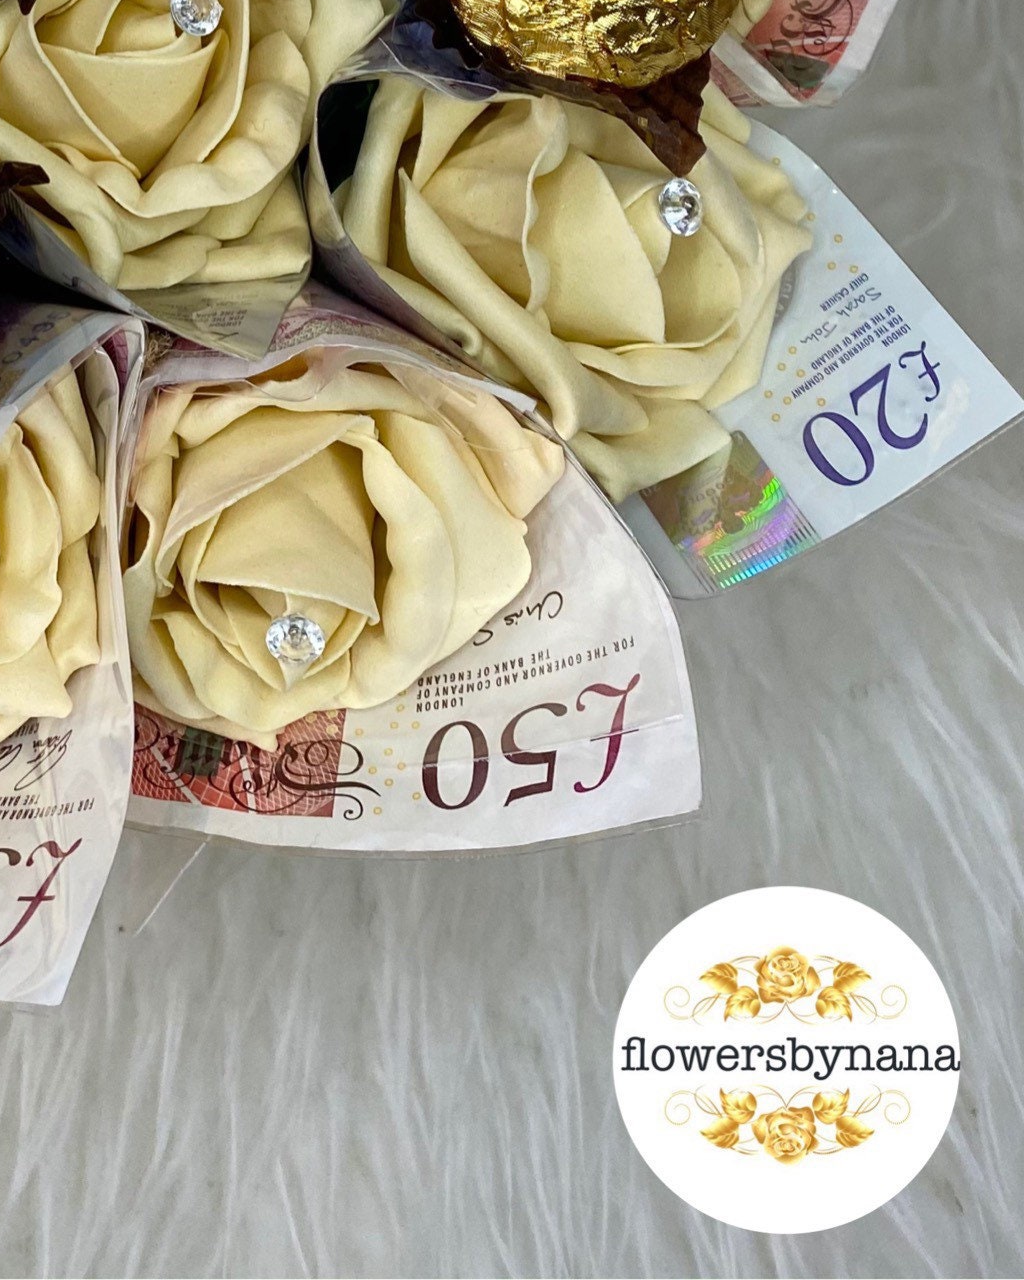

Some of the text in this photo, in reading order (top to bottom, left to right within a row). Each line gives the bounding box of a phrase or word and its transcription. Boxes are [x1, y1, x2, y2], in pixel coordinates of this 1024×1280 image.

[849, 272, 869, 292] CHIEF
[819, 287, 850, 312] CASHIER
[810, 305, 896, 371] OF THE BANK OF ENGLAND
[881, 323, 912, 348] LONDON
[791, 313, 904, 400] FOR THE GOVERNOR AND COMPANY
[802, 340, 941, 487] £20
[417, 635, 636, 700] FOR THE GOVERNOR AND COMPANY OF
[417, 648, 551, 687] THE BANK OF ENGLAND
[416, 697, 464, 713] LONDON
[421, 672, 641, 812] £50
[9, 804, 57, 820] GOVERNOR
[23, 794, 41, 806] THE
[58, 802, 75, 816] THE
[77, 797, 95, 812] FOR
